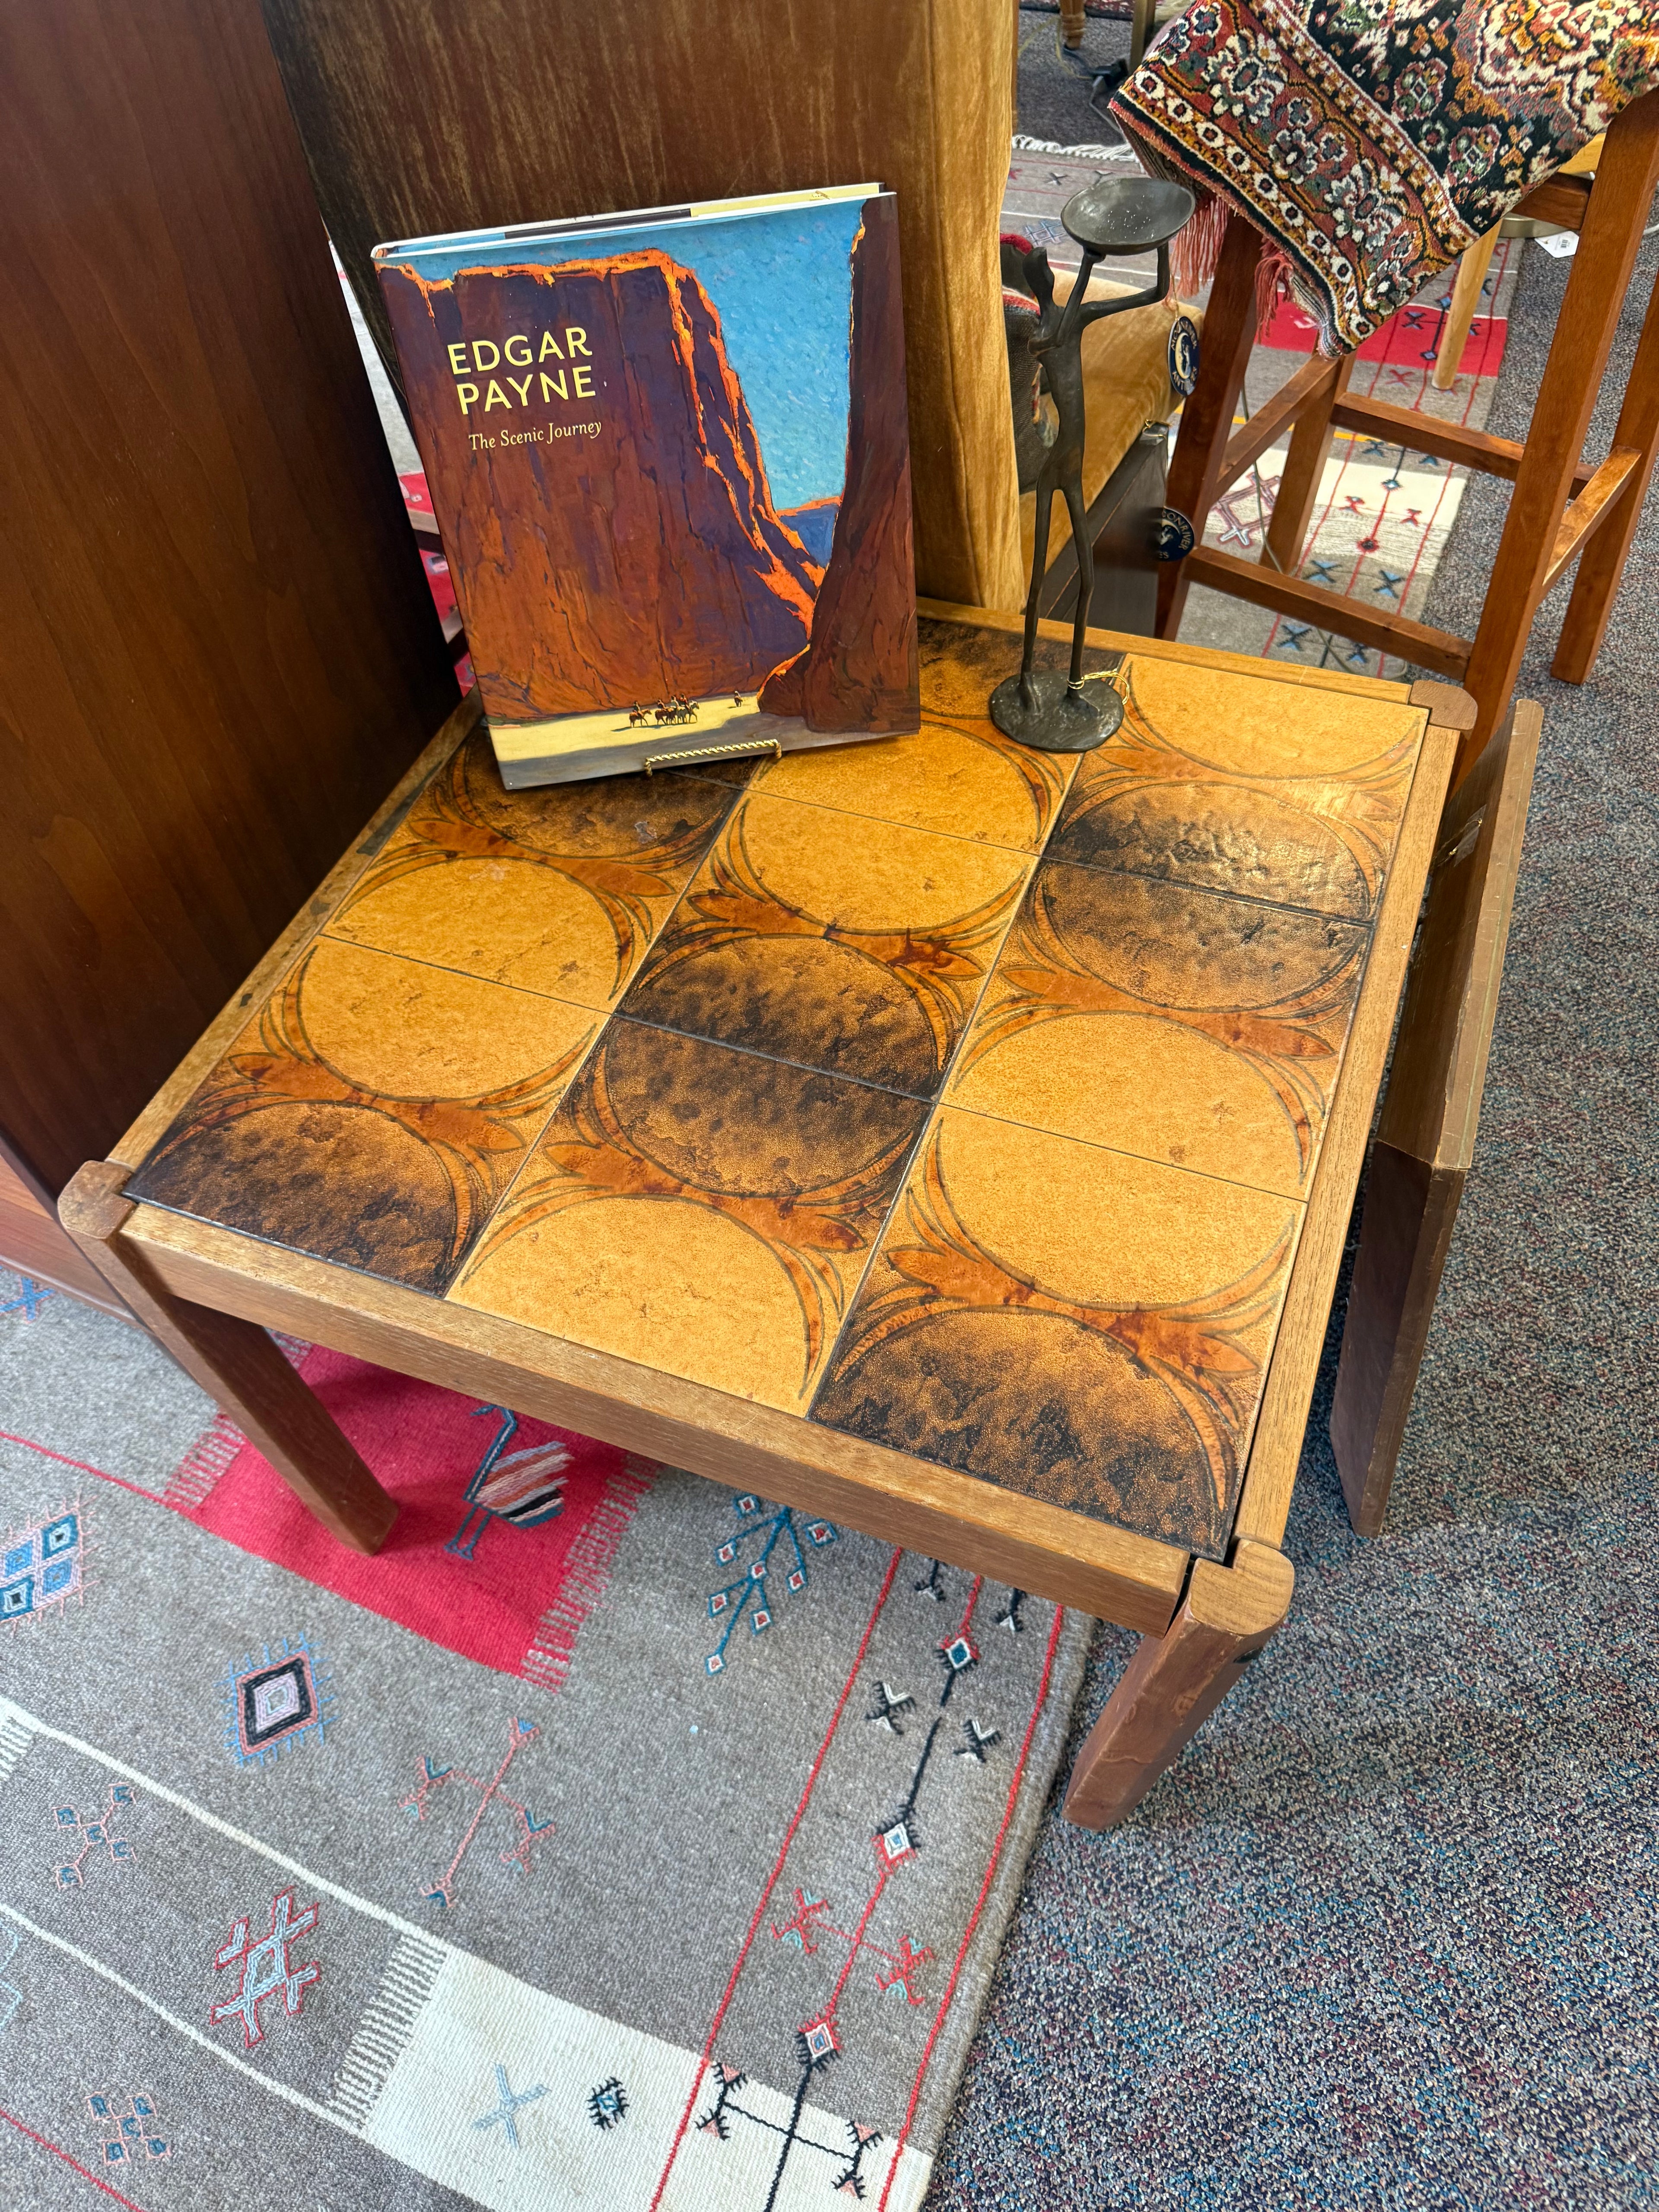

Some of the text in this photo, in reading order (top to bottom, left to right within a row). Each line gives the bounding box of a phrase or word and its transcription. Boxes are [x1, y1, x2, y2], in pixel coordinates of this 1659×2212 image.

[447, 327, 593, 375] EDGAR
[456, 365, 596, 415] PAYNE
[468, 421, 602, 450] The Scenic Journey
[1162, 511, 1191, 550] ONRIVER
